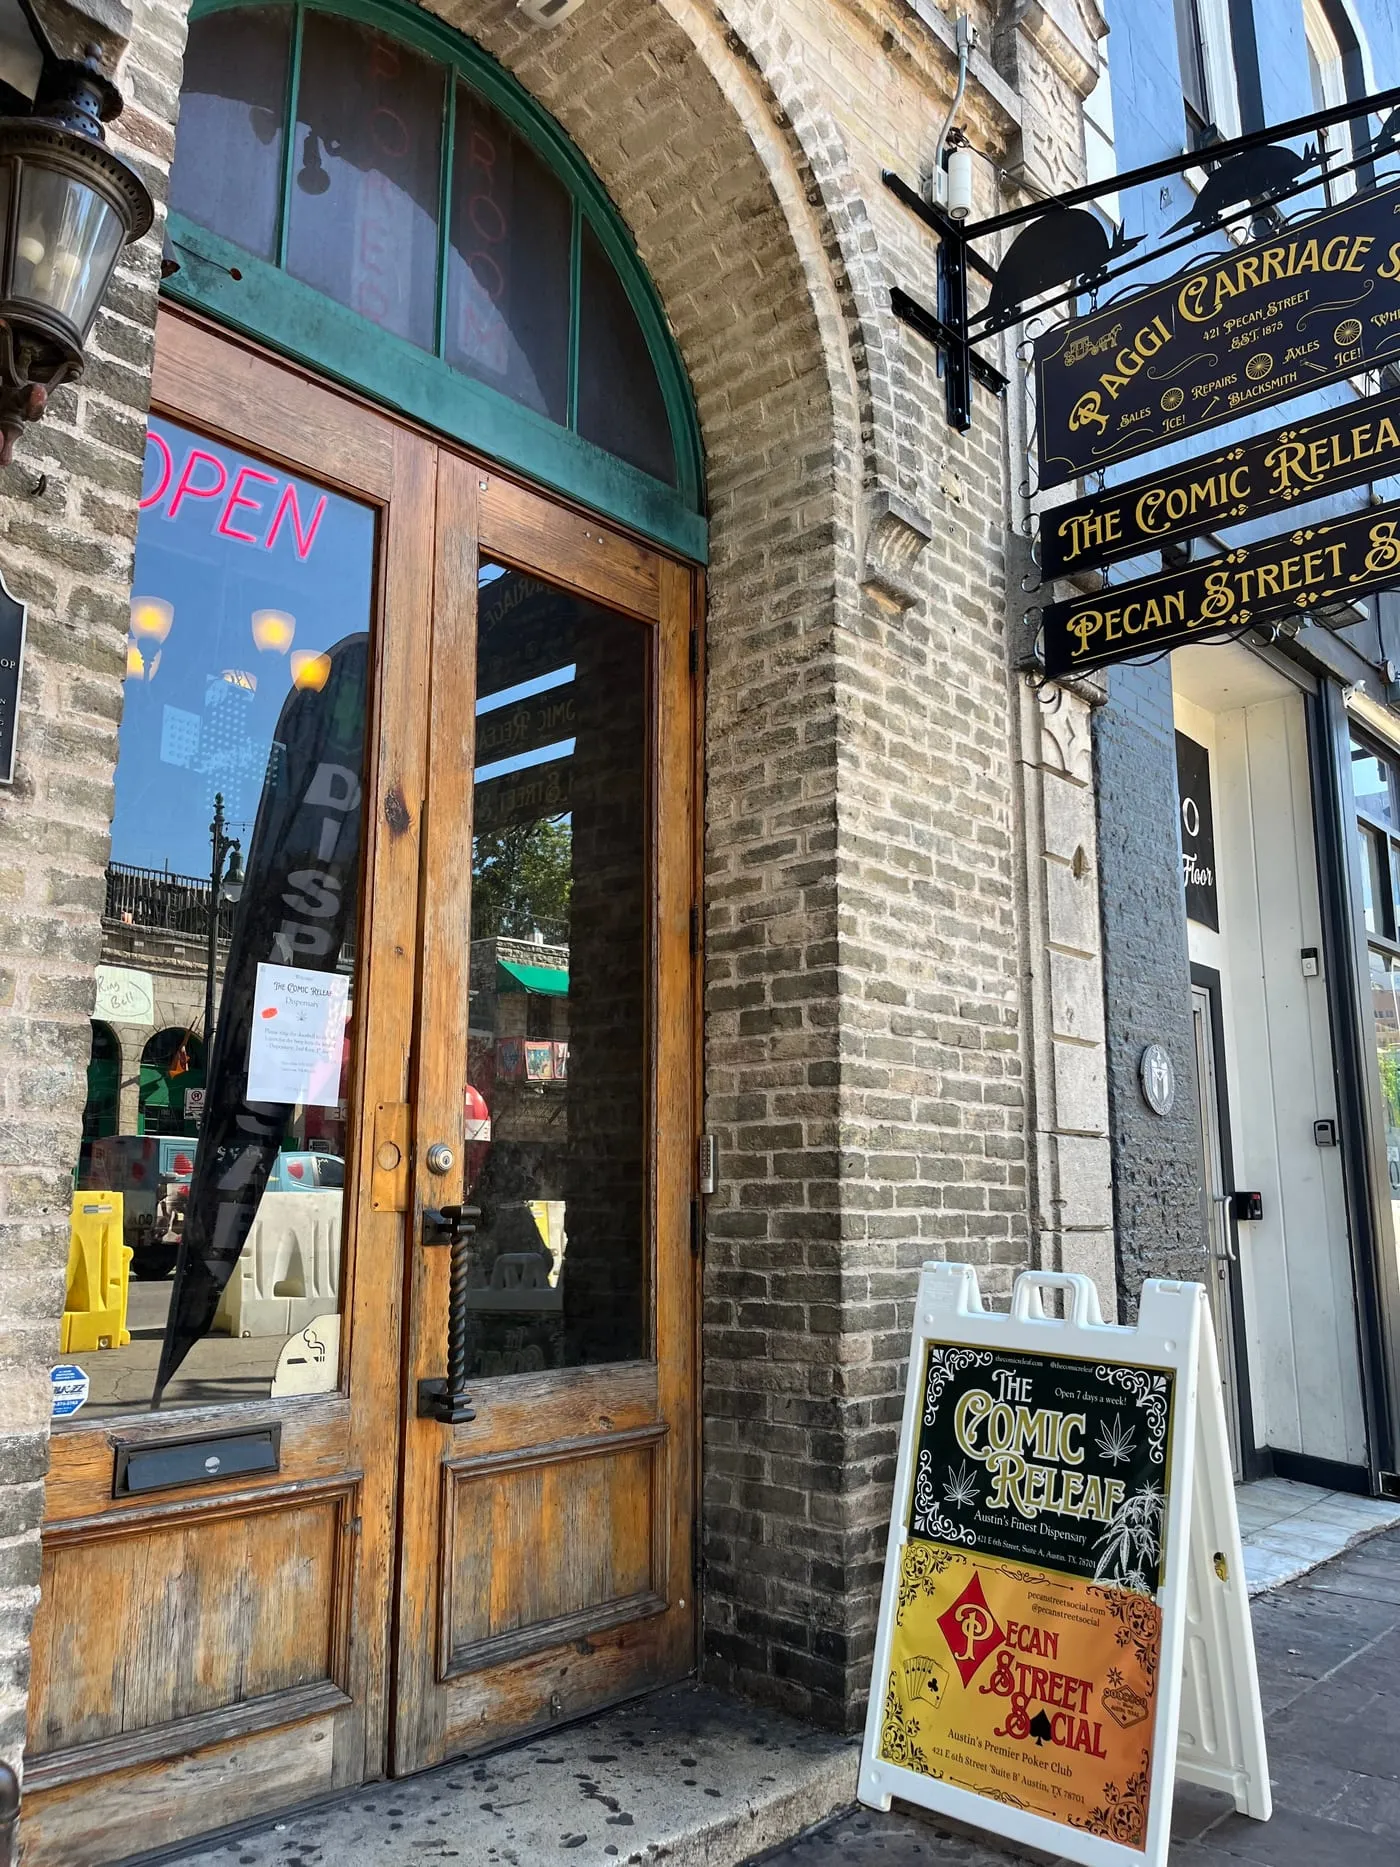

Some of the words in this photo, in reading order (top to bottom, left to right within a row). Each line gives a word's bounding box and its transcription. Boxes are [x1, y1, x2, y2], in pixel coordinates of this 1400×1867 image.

[1068, 315, 1174, 436] PAGGI
[1177, 236, 1376, 323] CARRIAGE
[1203, 327, 1219, 341] 421
[1223, 309, 1263, 335] PECAN
[1263, 289, 1310, 320] STREET
[1262, 321, 1283, 336] 1875
[1117, 407, 1151, 431] SALES
[1191, 374, 1237, 400] REPAIRS
[1283, 340, 1320, 364] AXLES
[1162, 415, 1185, 433] ICE!
[1228, 372, 1297, 408] BLACKSMITH
[1334, 348, 1361, 368] ICE!
[139, 431, 327, 558] OPEN
[1058, 509, 1122, 562] THE
[1135, 466, 1250, 534] COMIC
[1066, 591, 1186, 656] PECAN
[1187, 542, 1347, 627] STREET
[1182, 853, 1213, 888] Floor
[97, 975, 120, 992] Ring
[111, 991, 134, 1009] Bell
[273, 981, 286, 991] THE
[287, 983, 309, 994] COMIC
[991, 1369, 1033, 1403] THE
[1055, 1386, 1074, 1401] Open
[1075, 1389, 1082, 1400] 7
[1082, 1390, 1099, 1405] days
[1105, 1391, 1127, 1406] week!
[954, 1388, 1087, 1466] COMIC
[985, 1451, 1127, 1523] RELEAF
[974, 1510, 1009, 1527] Austin's
[1011, 1516, 1037, 1533] Finest
[1040, 1522, 1087, 1547] Dispensary
[993, 1538, 1001, 1547] 6th
[1022, 1544, 1037, 1555] Suite
[1078, 1557, 1096, 1569] 78701
[1027, 1591, 1106, 1616] pecanstreetsocial.com
[1032, 1603, 1100, 1627] @pecanstreetsocial
[979, 1650, 1093, 1715] STREET
[932, 1746, 943, 1756] 421
[951, 1752, 964, 1764] 6th
[964, 1755, 988, 1772] Street
[1051, 1785, 1062, 1797] TX
[1064, 1790, 1085, 1804] 78701
[948, 1728, 982, 1749] Austin's
[984, 1740, 1020, 1761] Premier
[1022, 1752, 1049, 1770] Poker
[1050, 1759, 1073, 1777] Club
